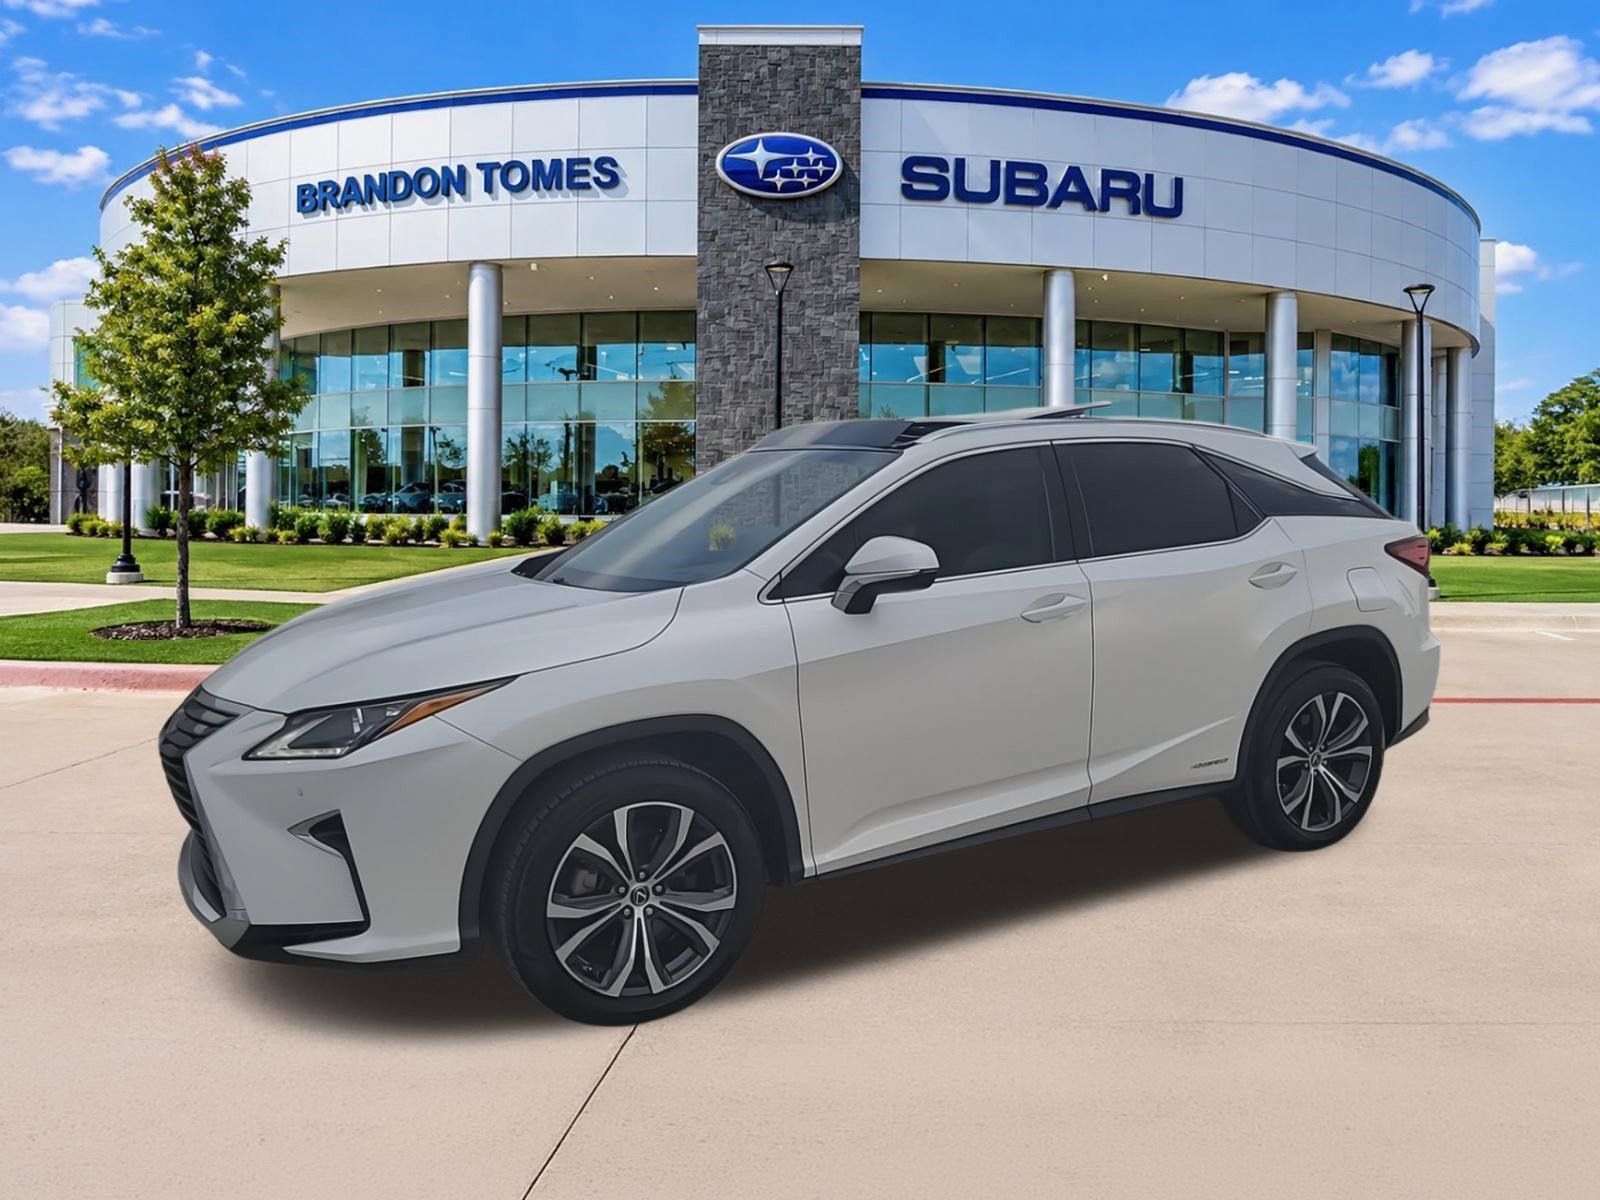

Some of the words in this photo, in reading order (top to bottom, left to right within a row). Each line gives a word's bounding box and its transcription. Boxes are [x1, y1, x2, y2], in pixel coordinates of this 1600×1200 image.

[297, 164, 467, 214] BRANDON
[476, 156, 620, 194] TOMES
[901, 155, 1183, 218] SUBARU
